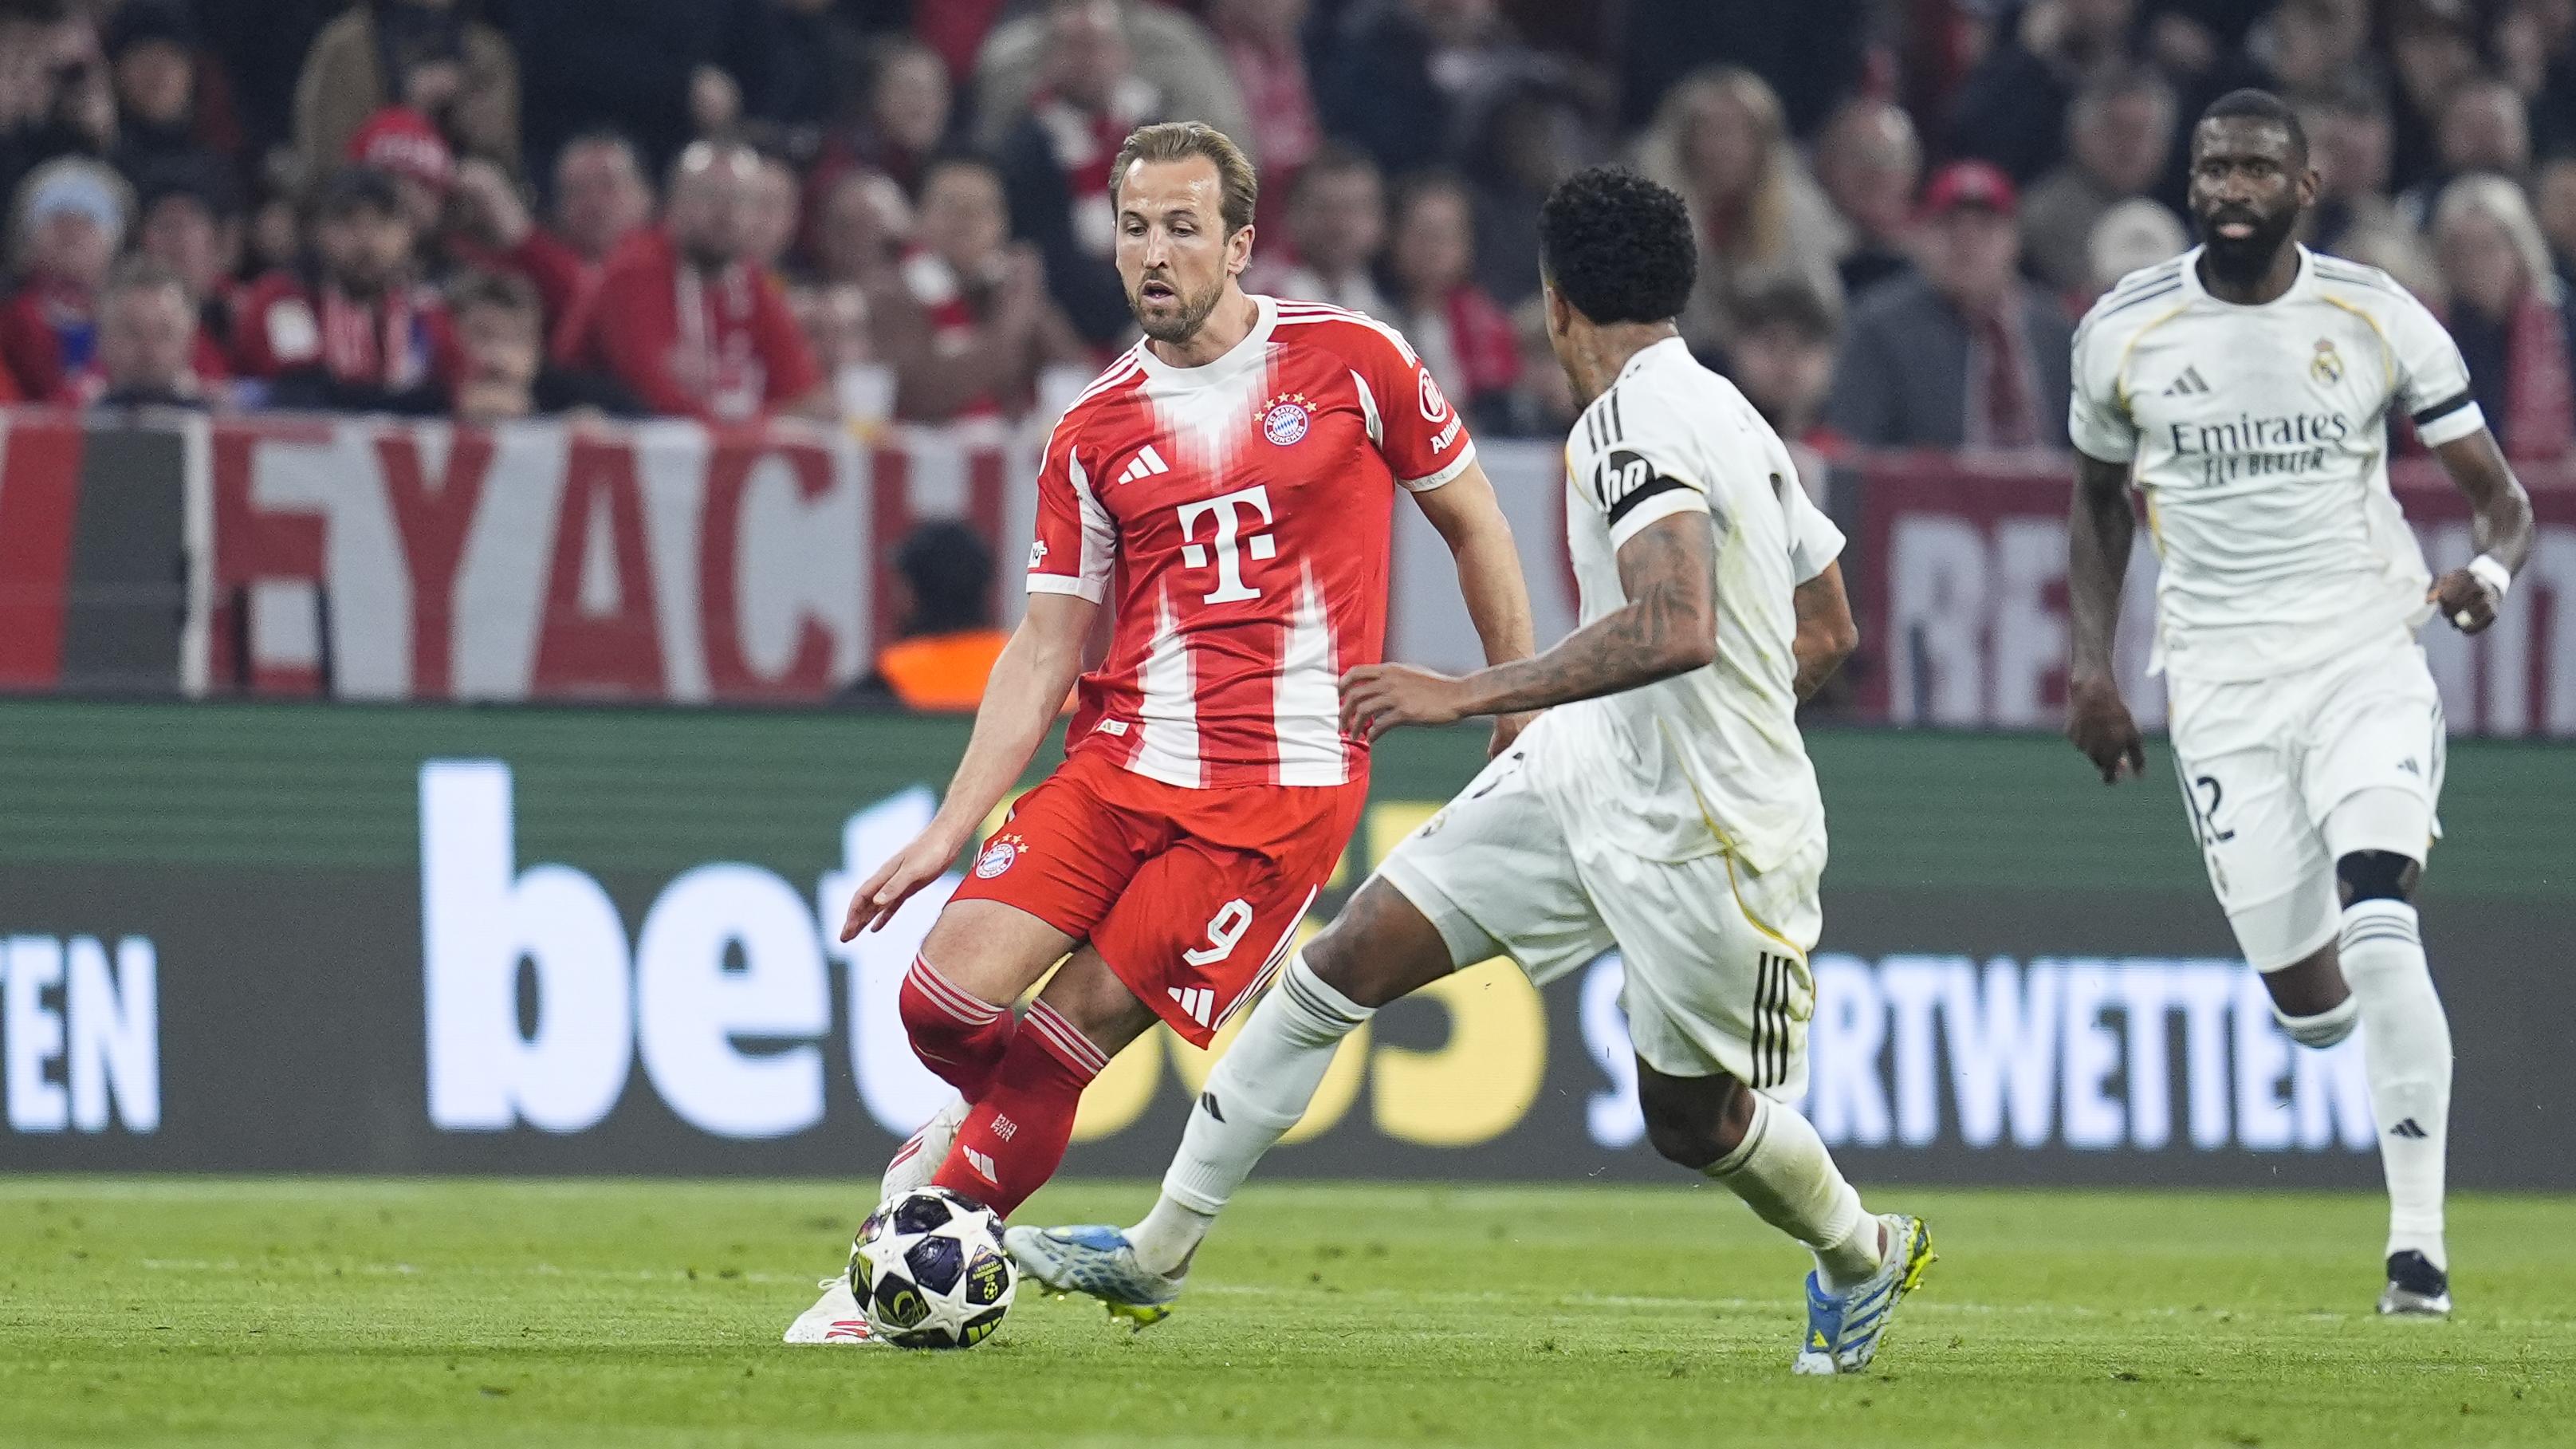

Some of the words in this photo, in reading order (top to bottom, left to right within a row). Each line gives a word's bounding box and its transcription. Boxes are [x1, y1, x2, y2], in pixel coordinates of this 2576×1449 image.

[2169, 411, 2346, 455] Emirates
[2202, 455, 2239, 486] FLY
[1182, 898, 1253, 967] 9
[0, 935, 161, 1134] EN
[1579, 951, 2378, 1150] SRTWETTEN
